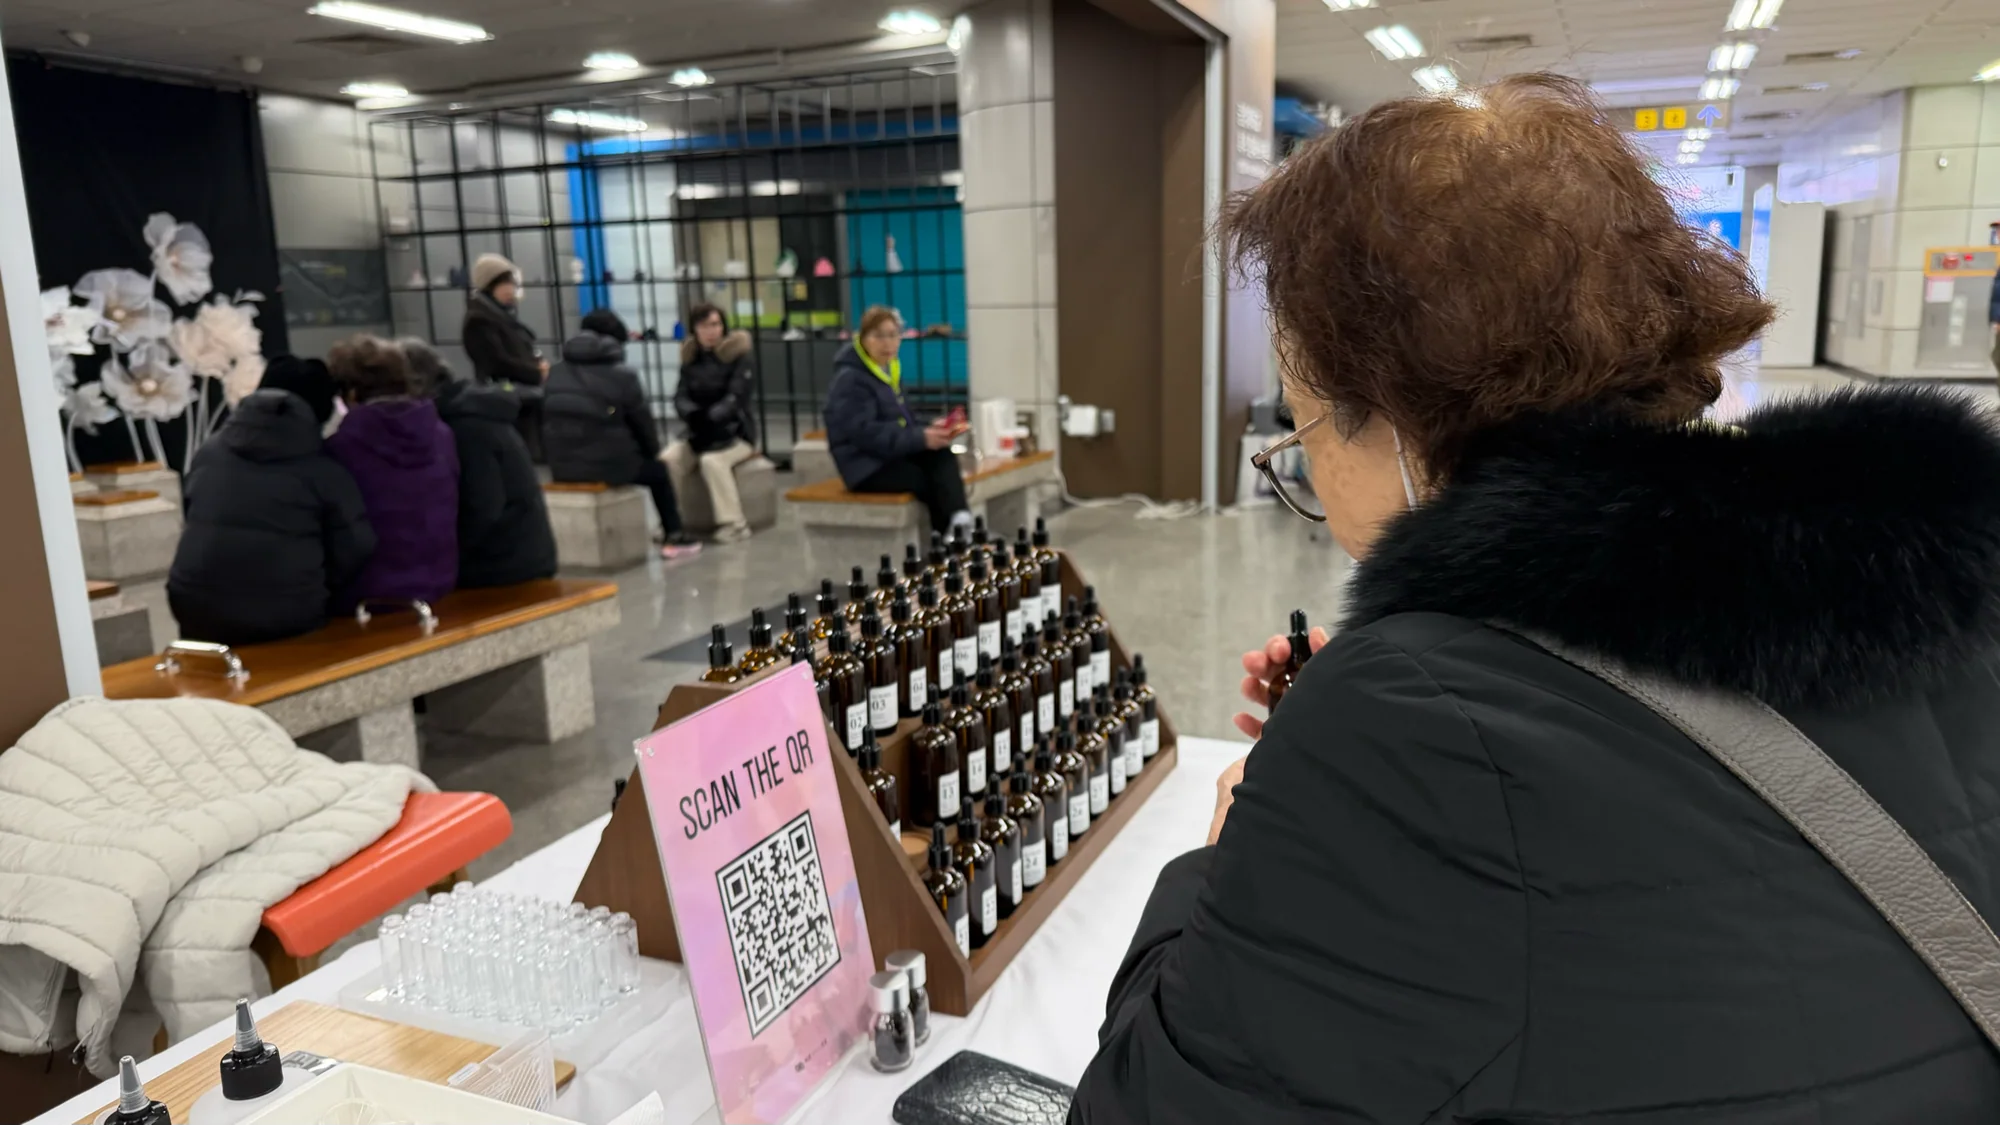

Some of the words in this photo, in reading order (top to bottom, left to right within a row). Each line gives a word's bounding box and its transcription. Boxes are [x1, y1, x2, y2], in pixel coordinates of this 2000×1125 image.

[872, 700, 886, 711] 03
[850, 717, 862, 729] 02
[679, 770, 741, 840] SCAN
[742, 745, 784, 800] THE
[786, 729, 814, 774] QR
